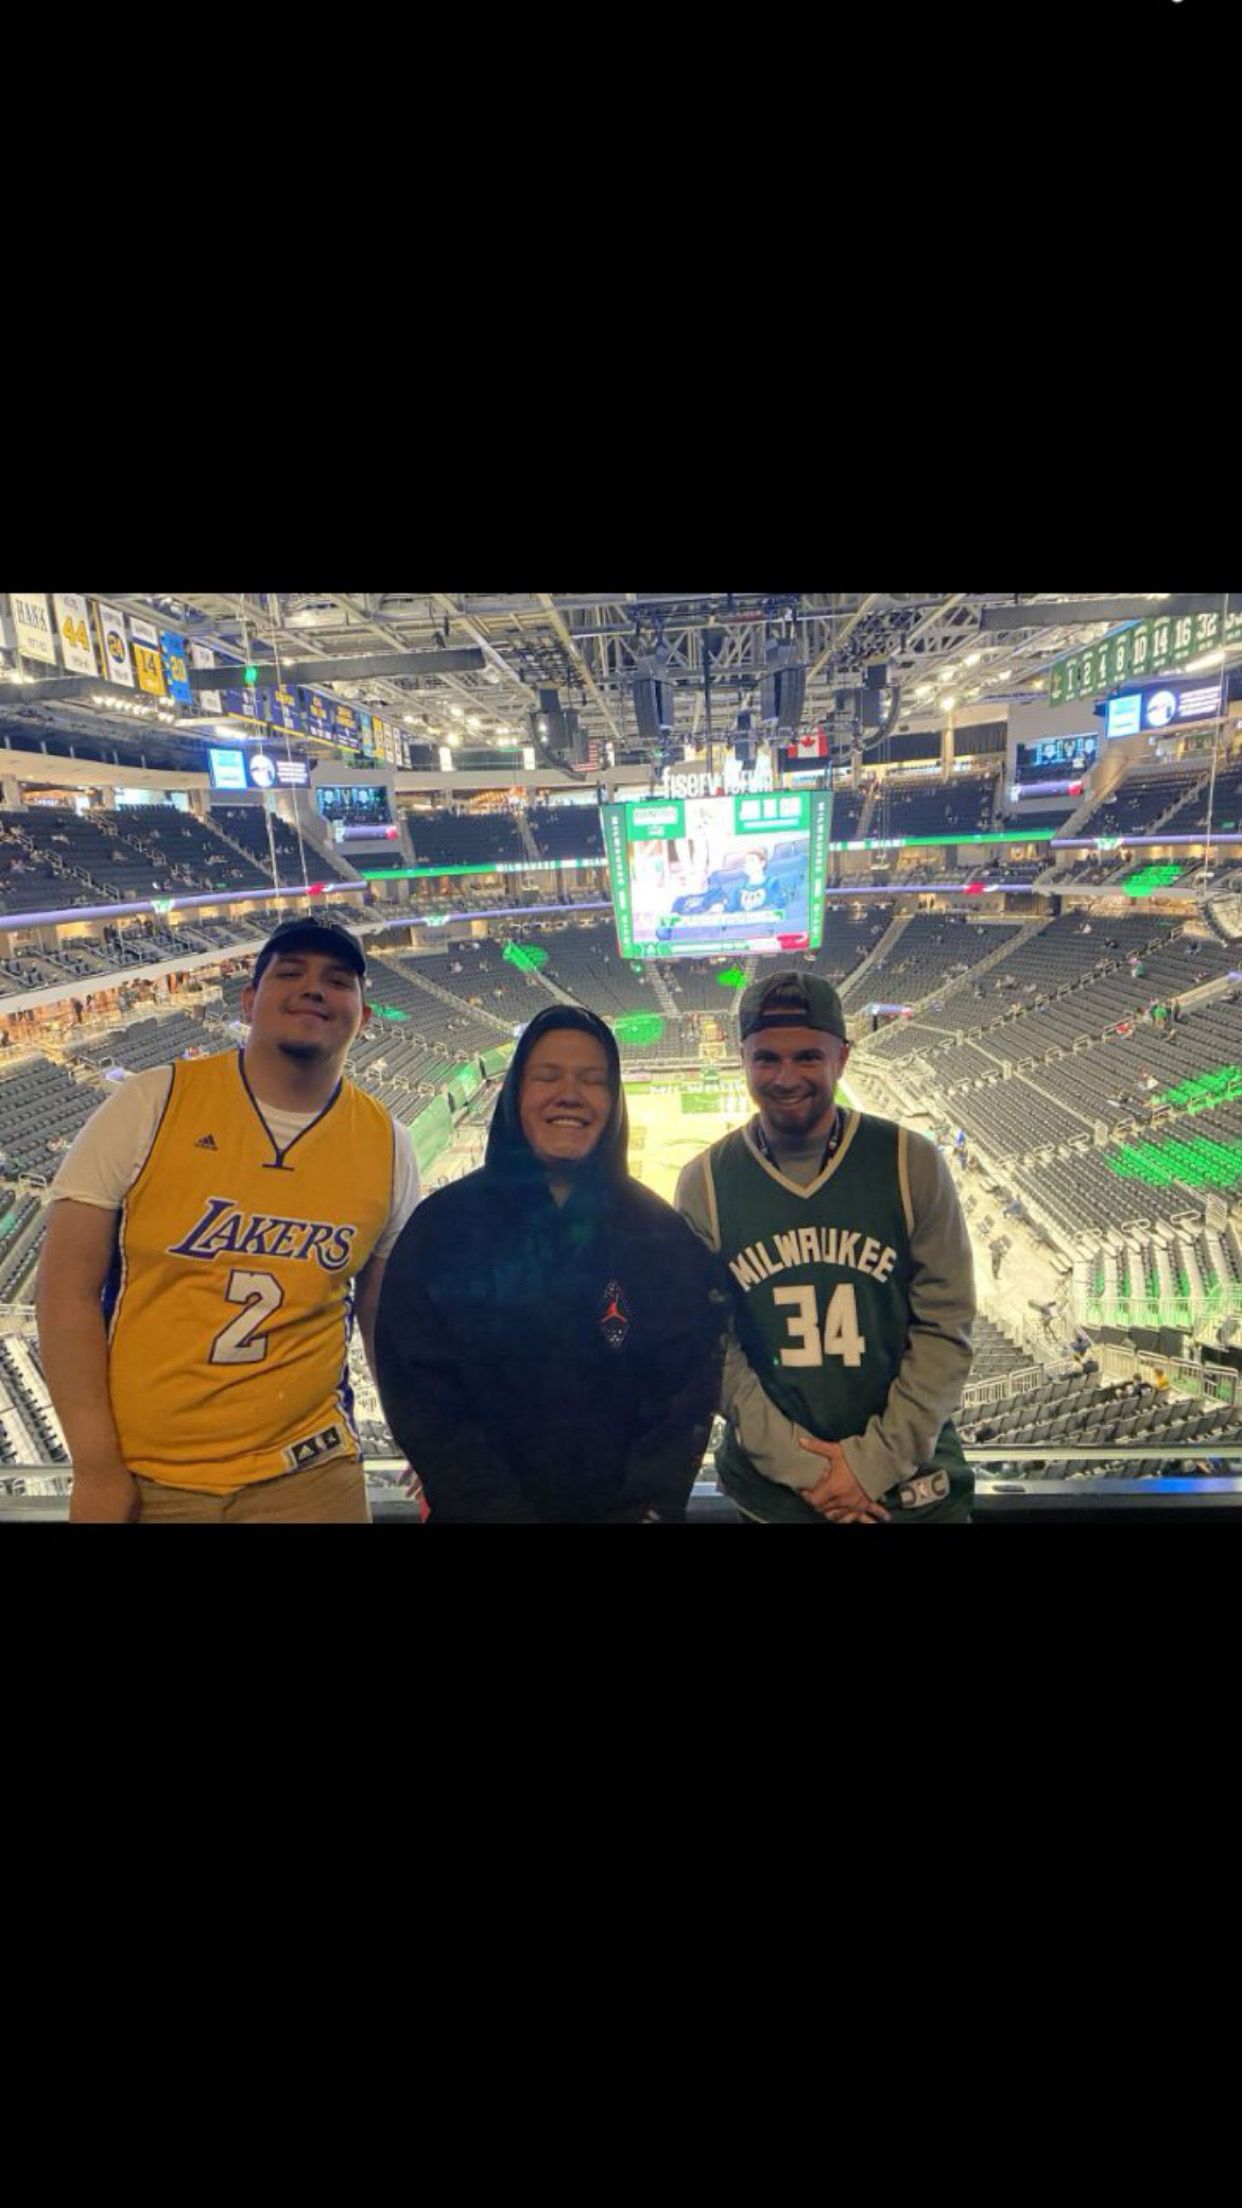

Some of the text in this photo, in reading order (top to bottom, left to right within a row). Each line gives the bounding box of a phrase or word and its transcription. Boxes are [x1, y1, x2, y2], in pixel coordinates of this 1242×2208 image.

[63, 615, 90, 652] 44
[1152, 626, 1168, 657] 14
[1174, 616, 1192, 649] 16
[140, 649, 158, 677] 14
[1116, 646, 1124, 671] 8
[1133, 636, 1146, 665] 10
[1082, 661, 1091, 685] 2
[168, 1196, 356, 1271] LAKERS
[728, 1226, 897, 1292] MILWAUKEE
[208, 1269, 285, 1366] 2
[773, 1283, 866, 1368] 34
